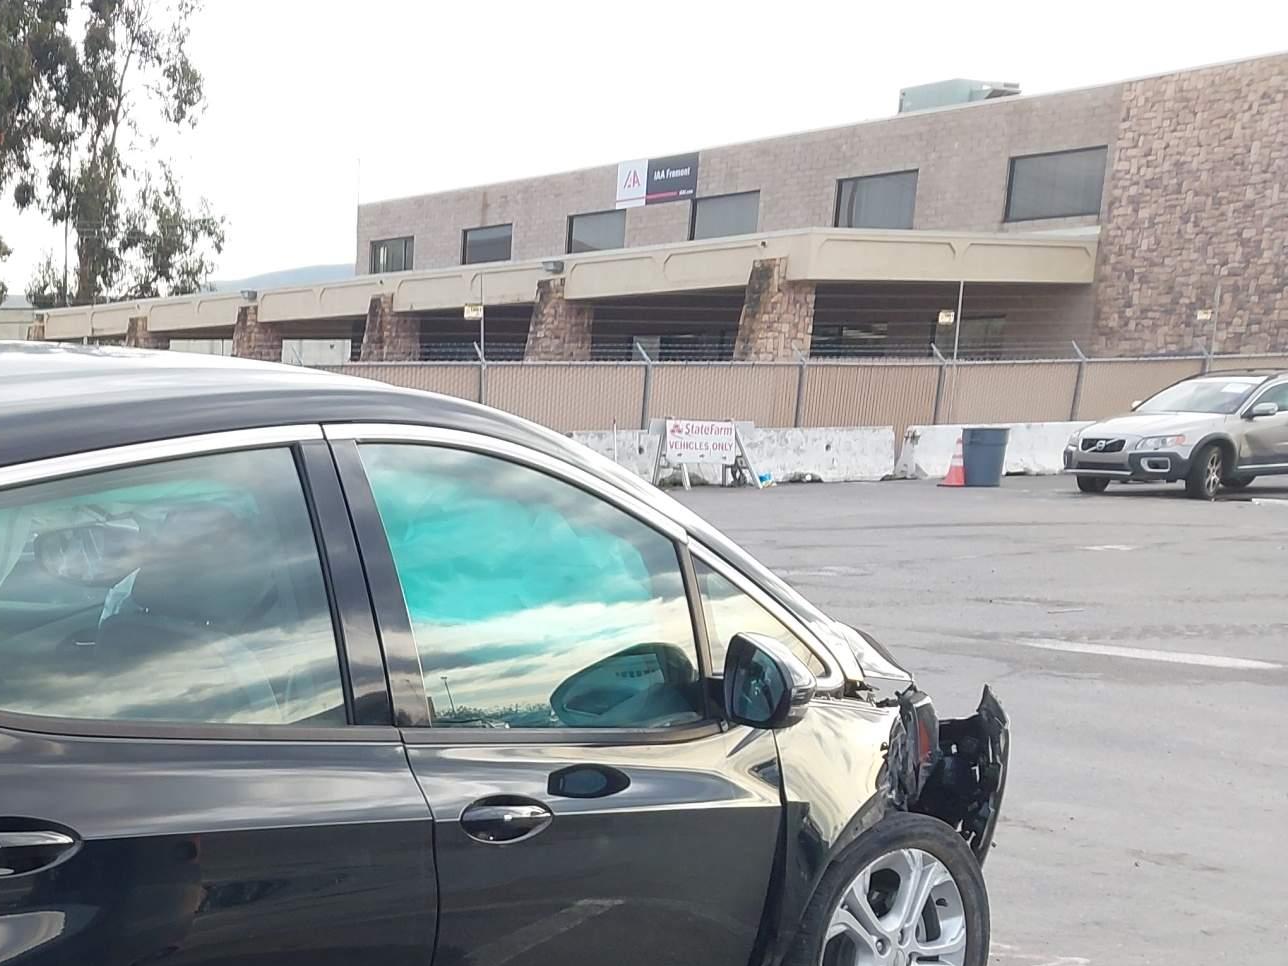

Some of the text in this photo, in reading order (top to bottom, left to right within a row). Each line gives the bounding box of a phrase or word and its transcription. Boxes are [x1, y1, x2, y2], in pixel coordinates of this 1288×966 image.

[666, 167, 690, 179] Fremont
[669, 440, 733, 451] VEHICLES ONLY
